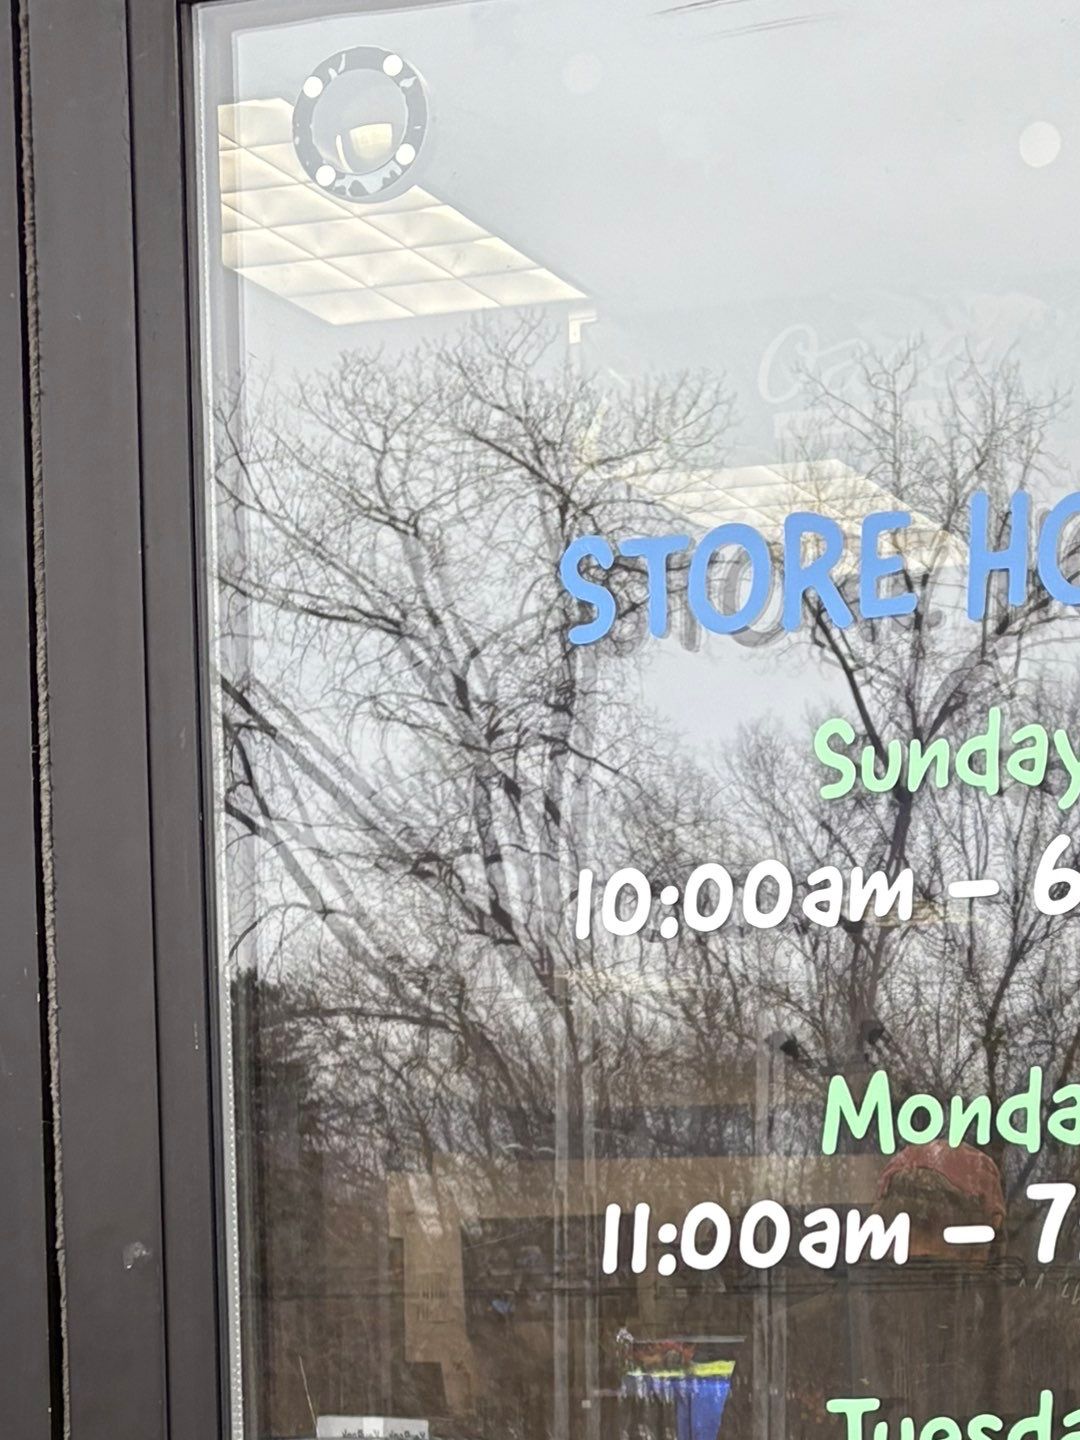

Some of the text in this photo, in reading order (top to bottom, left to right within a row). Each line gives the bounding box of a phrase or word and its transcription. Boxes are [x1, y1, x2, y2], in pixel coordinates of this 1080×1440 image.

[559, 510, 918, 647] STORE
[574, 858, 916, 941] 10:00am
[602, 1199, 912, 1275] 11:00am
